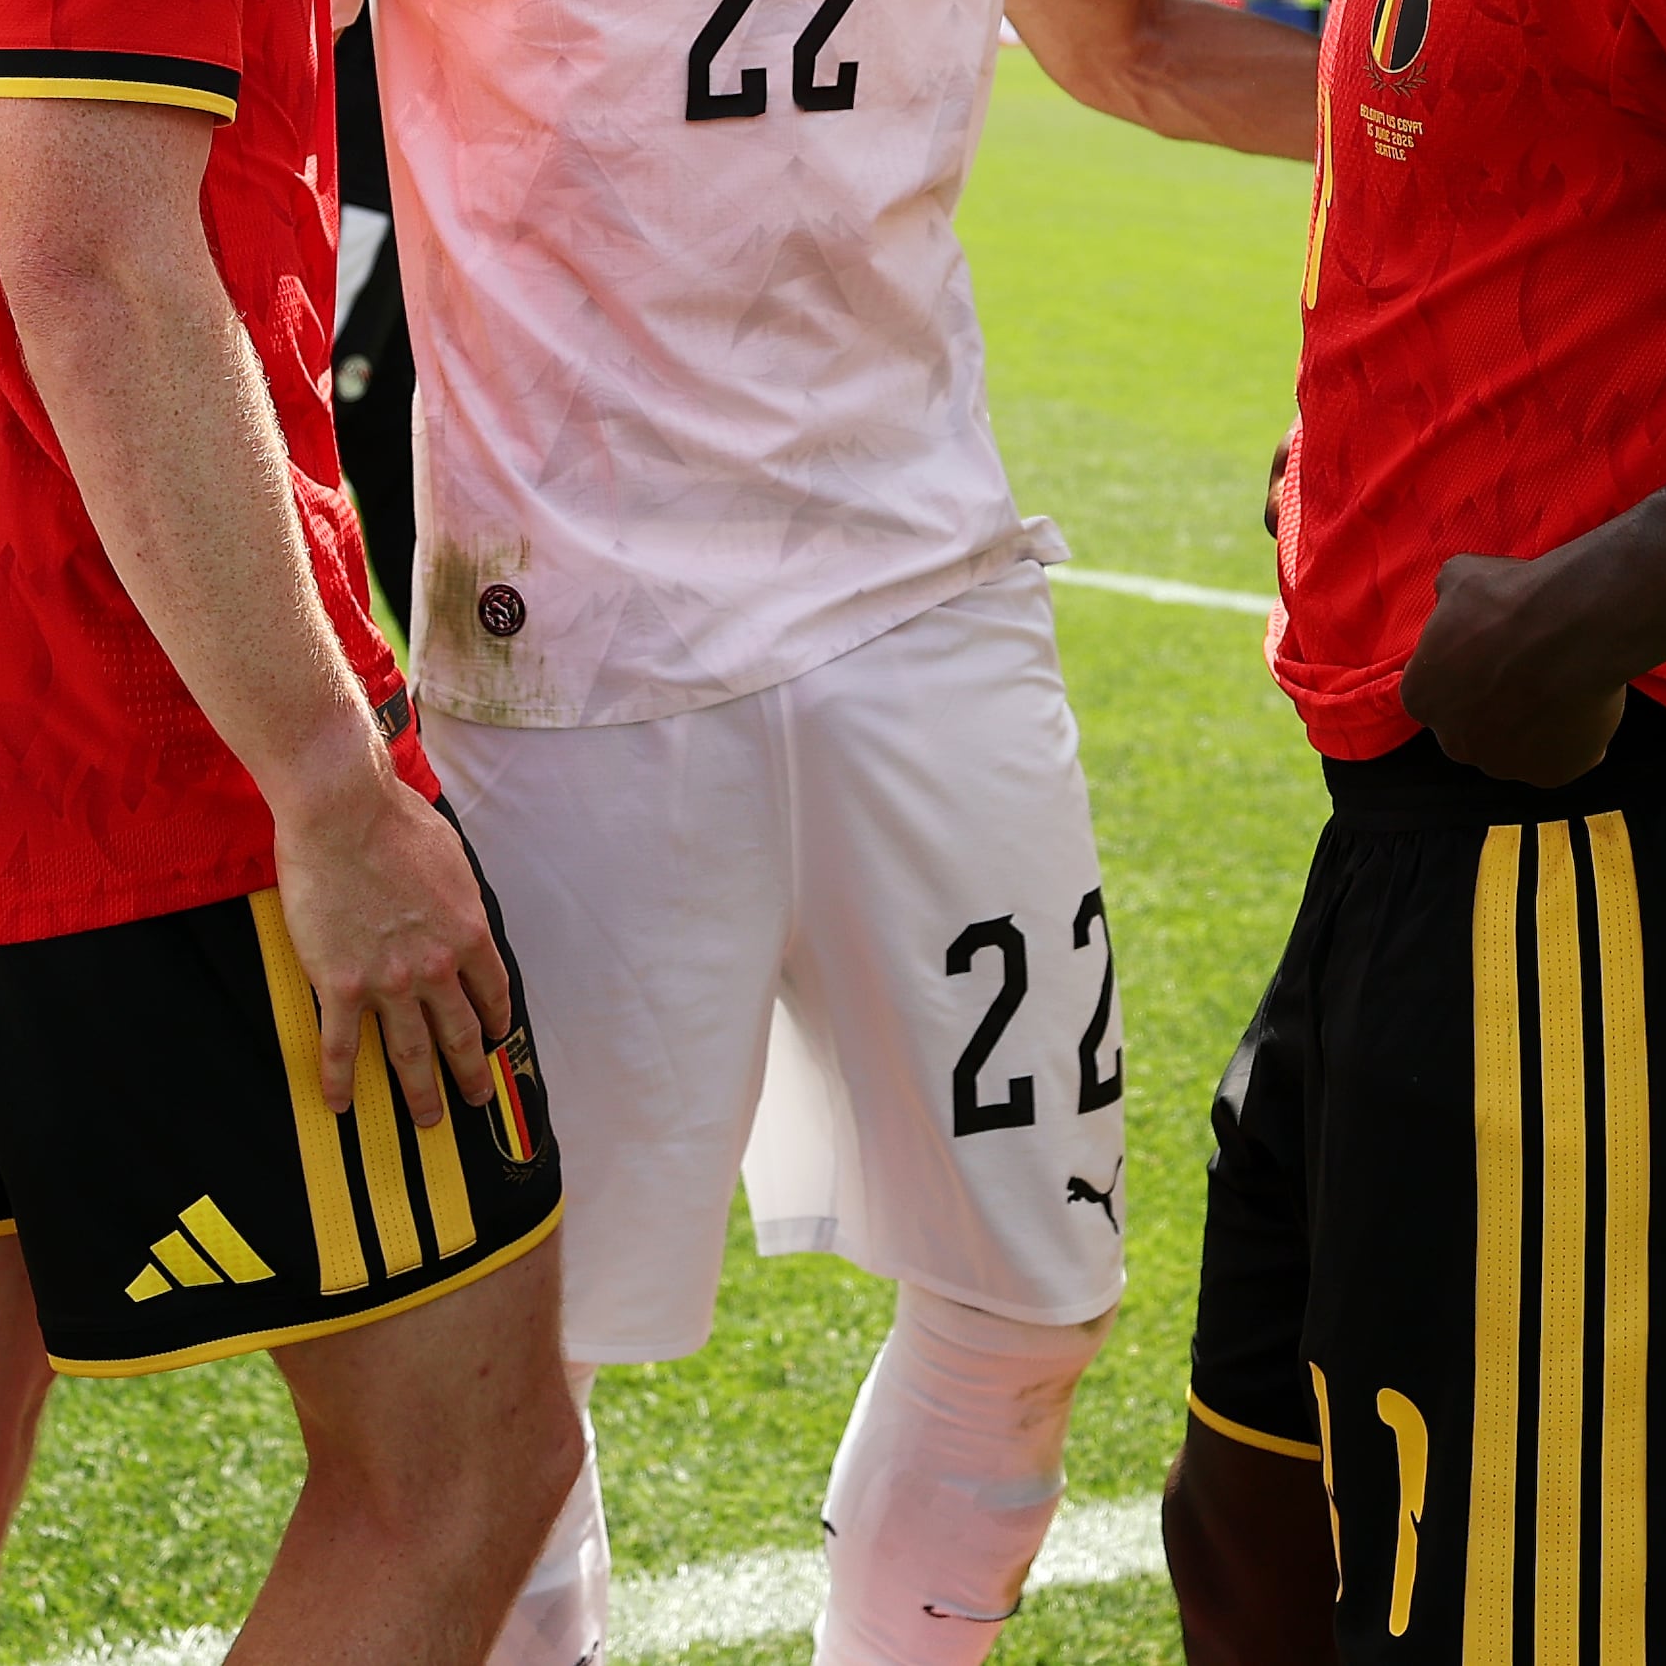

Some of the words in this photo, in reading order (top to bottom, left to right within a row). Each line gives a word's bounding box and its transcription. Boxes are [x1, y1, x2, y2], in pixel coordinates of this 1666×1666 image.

[1375, 125, 1391, 143] JUNE
[1391, 131, 1414, 148] 2026
[1397, 117, 1423, 135] EGYPT
[1375, 141, 1406, 161] SEATTLE
[946, 886, 1123, 1137] 22
